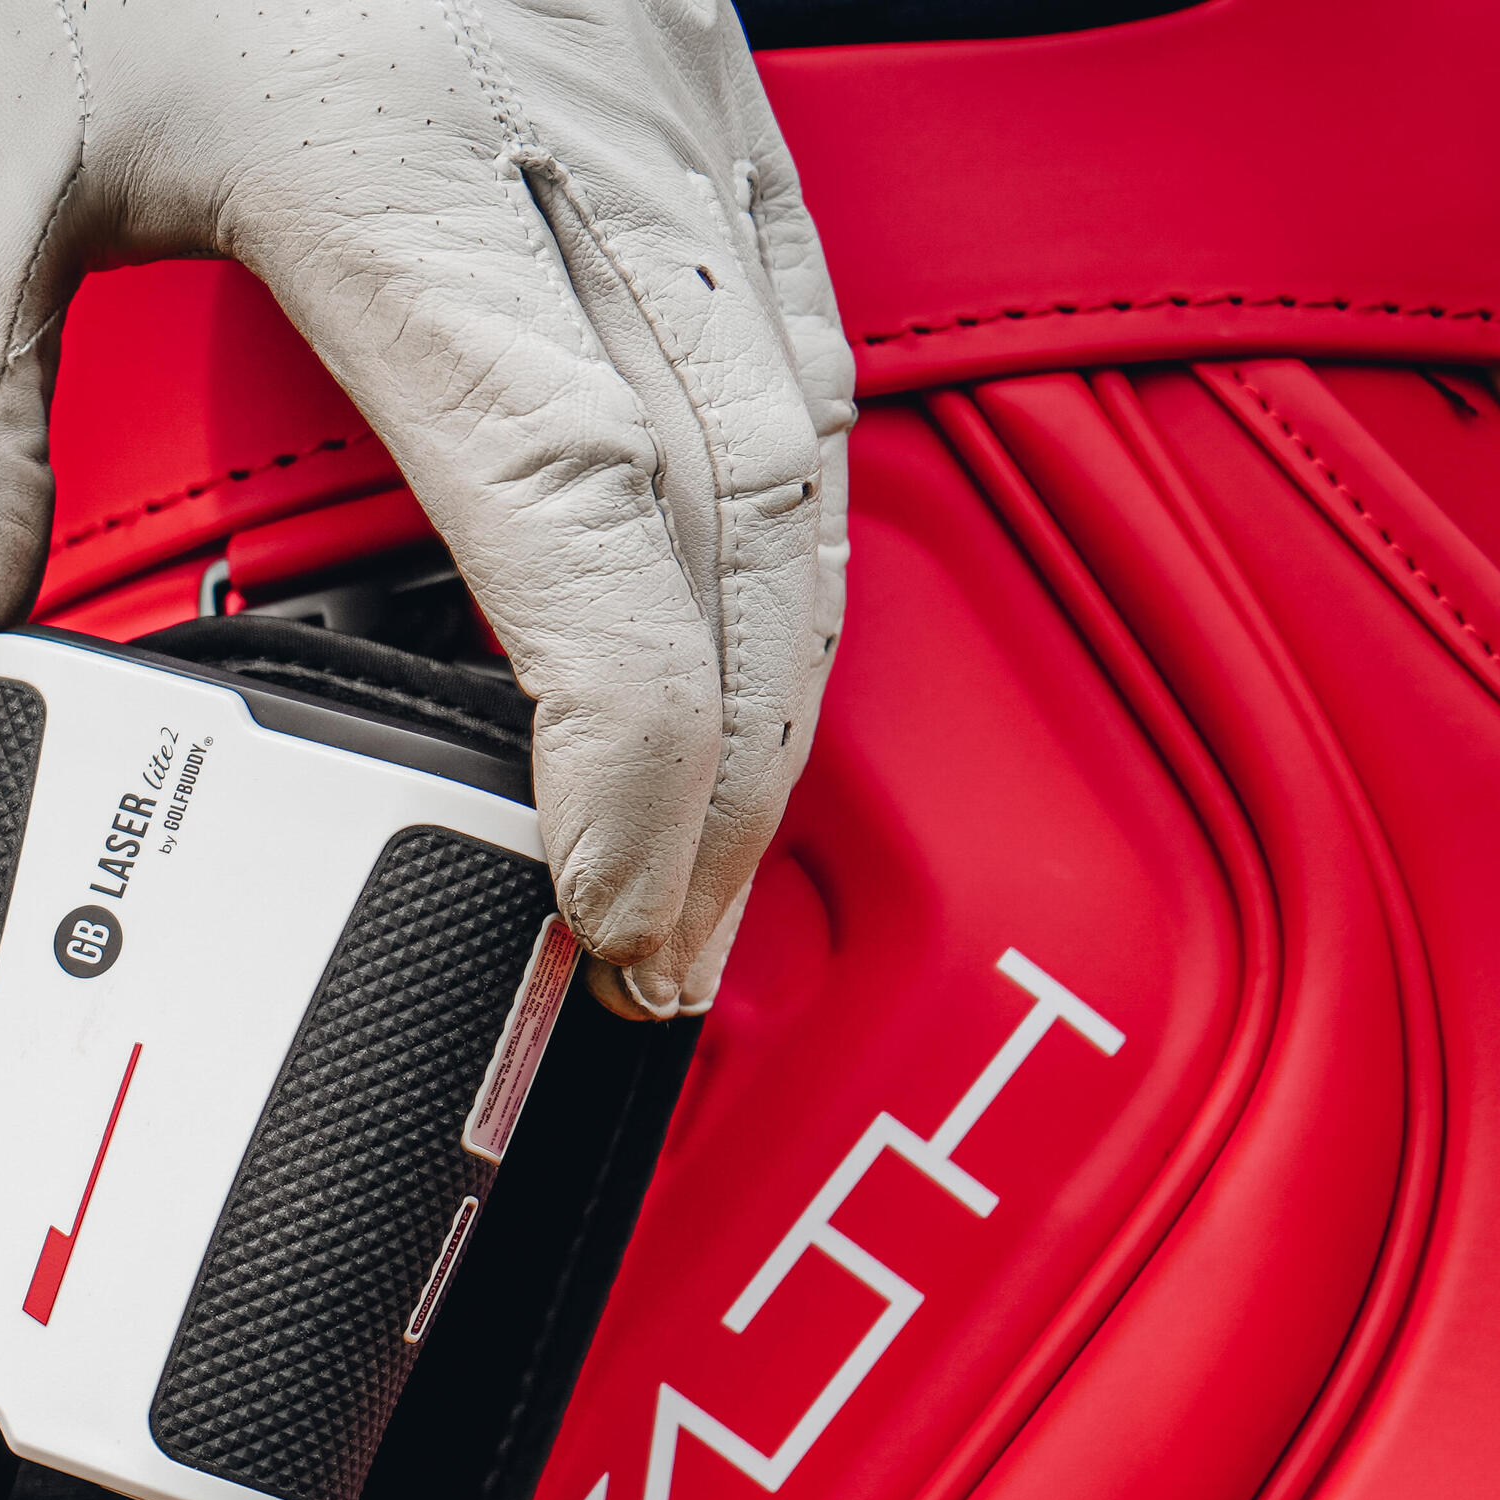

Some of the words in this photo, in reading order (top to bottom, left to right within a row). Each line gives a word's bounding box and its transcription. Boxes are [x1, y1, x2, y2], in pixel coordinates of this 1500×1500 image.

[65, 918, 111, 966] GB
[89, 792, 158, 899] LASER
[142, 744, 175, 791] lite
[159, 726, 180, 745] 2
[158, 834, 178, 855] by
